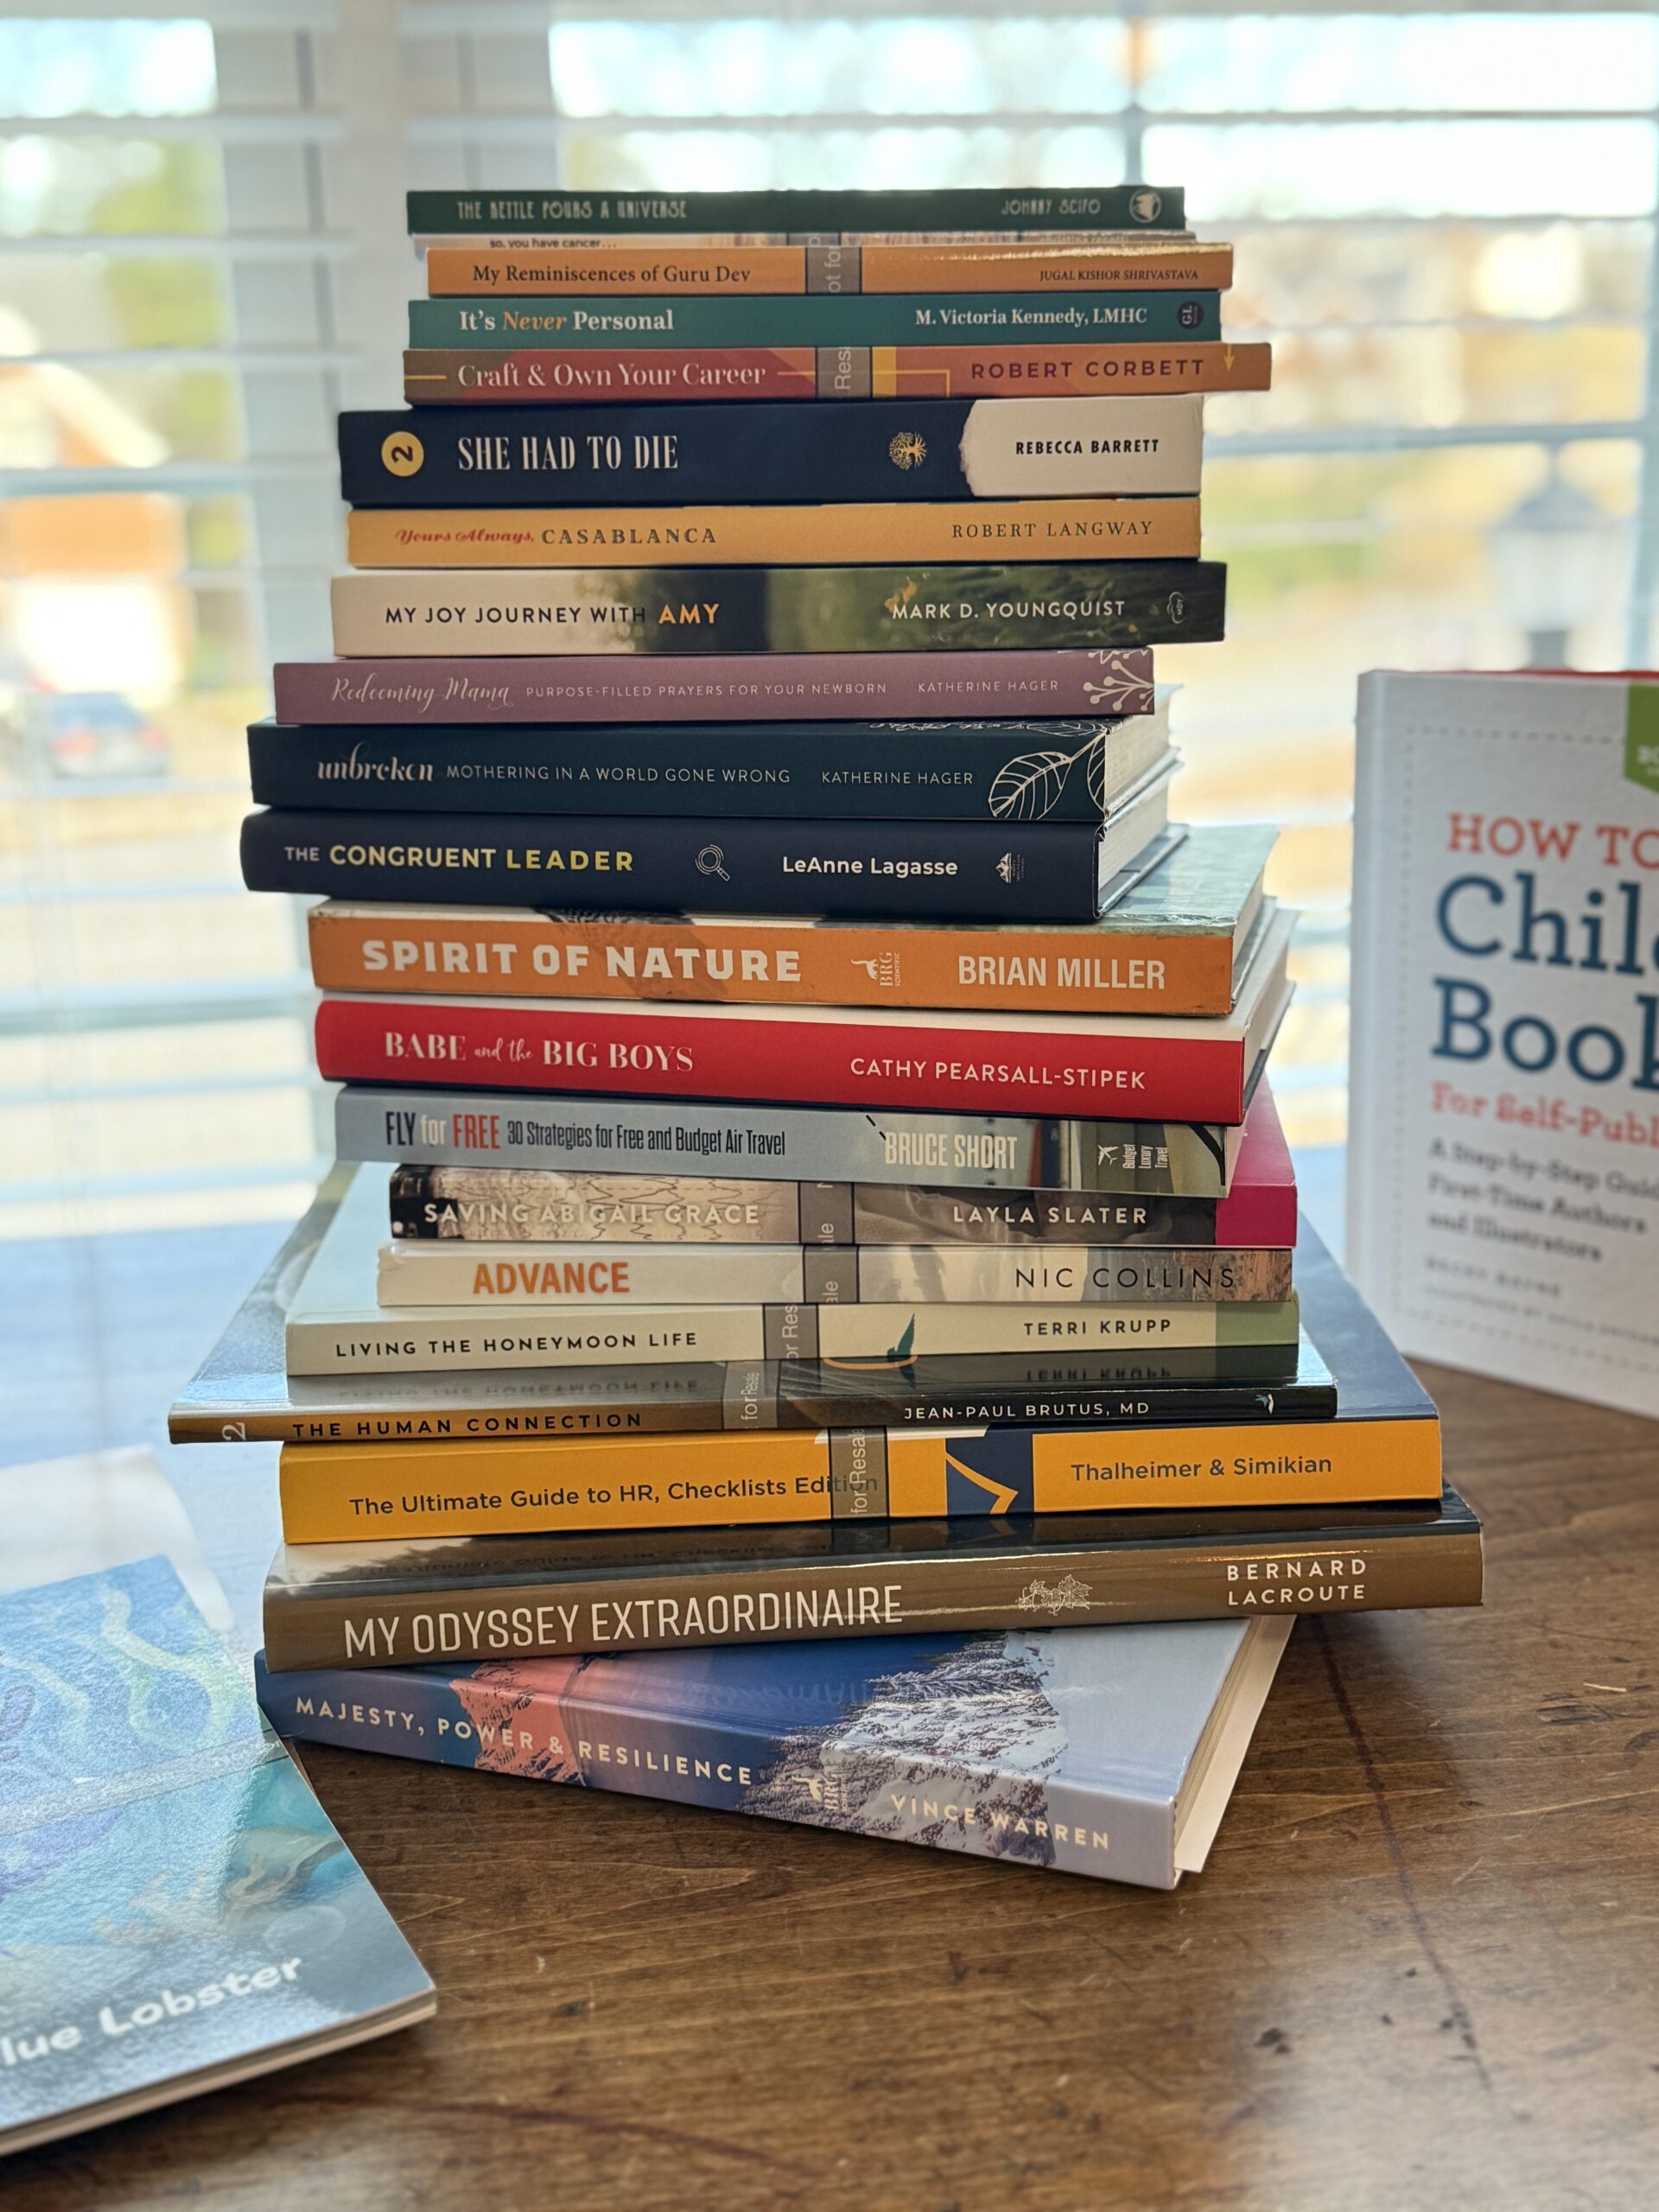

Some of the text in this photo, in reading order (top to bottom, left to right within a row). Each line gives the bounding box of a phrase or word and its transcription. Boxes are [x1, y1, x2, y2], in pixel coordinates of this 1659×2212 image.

[458, 201, 481, 219] THE
[543, 201, 593, 219] POURS
[601, 202, 610, 219] A
[618, 200, 687, 219] UNIVERSE
[509, 238, 559, 249] you have
[473, 264, 750, 286] My Reminiscences of Guru Dev
[1039, 269, 1198, 282] JUGAL KISHOR SHRIVASTAVA
[459, 309, 674, 331] It's Never Personal
[915, 307, 1147, 328] M. Victoria Kennedy, LMHC
[458, 362, 766, 387] Craft & Own Your Career
[972, 359, 1205, 379] ROBERT CORBETT
[391, 446, 413, 463] 2
[458, 435, 678, 471] SHE HAD TO DIE
[1015, 439, 1160, 454] REBECCA BARRETT
[396, 528, 716, 545] Yours Always, CASABLANCA
[951, 521, 1153, 538] ROBERT LANGWAY
[385, 603, 720, 625] MY JOY JOURNEY WITH AMY
[892, 601, 1125, 620] MARK D. YOUNGQUIST
[331, 672, 886, 713] Redeeming Mama PURPOSE-FILLED PRAYERS FOR YOUR NEWBORN
[918, 680, 1058, 692] KATHERINE HAGER
[317, 741, 790, 783] unbroken MOTHERING IN A WORLD GONE WRONG
[1446, 812, 1659, 869] HOW TO
[285, 845, 633, 872] THE CONGRUENT LEADER
[783, 855, 958, 880] LeAnne Lagasse
[1437, 870, 1659, 977] Chil
[362, 939, 802, 982] SPIRIT OF NATURE
[879, 952, 893, 986] BRG
[958, 955, 1165, 990] BRIAN MILLER
[385, 1031, 694, 1072] BABE and the BIG BOYS
[850, 1058, 1146, 1090] CATHY PEARSALL-STIPEK
[1432, 1080, 1490, 1118] For
[385, 1111, 785, 1157] FLY for FREE 30 Strategies for Free and Budget Air Travel
[885, 1131, 1017, 1170] BRUCE SHORT
[1122, 1144, 1137, 1169] Budget
[1139, 1145, 1154, 1169] Luxury
[1154, 1147, 1169, 1168] Travel
[424, 1204, 759, 1225] SAVING ABIGAIL GRACE
[953, 1206, 1147, 1224] LAYLA SLATER
[473, 1262, 630, 1294] ADVANCE
[1015, 1267, 1236, 1288] NIC COLLINS
[1024, 1319, 1172, 1336] TERRI KRUPP
[335, 1332, 697, 1357] LIVING THE HONEYMOON LIFE
[741, 1396, 758, 1421] for
[904, 1402, 1149, 1421] JEAN-PAUL BRUTUS, MD
[292, 1413, 643, 1439] THE HUMAN CONNECTION
[1071, 1454, 1332, 1482] Thalheimer & Simikian
[349, 1474, 878, 1516] The Ultimate Guide to HR, Checklists Edition
[850, 1491, 868, 1514] for
[1227, 1558, 1367, 1581] BERNARD
[1227, 1585, 1365, 1607] LACROUTE
[344, 1584, 903, 1659] MY ODYSSEY EXTRAORDINAIRE
[296, 1696, 753, 1785] MAJESTY, POWER & RESILIENCE
[891, 1795, 1109, 1850] VINCE WARREN
[0, 1957, 302, 2067] lue Lobster
